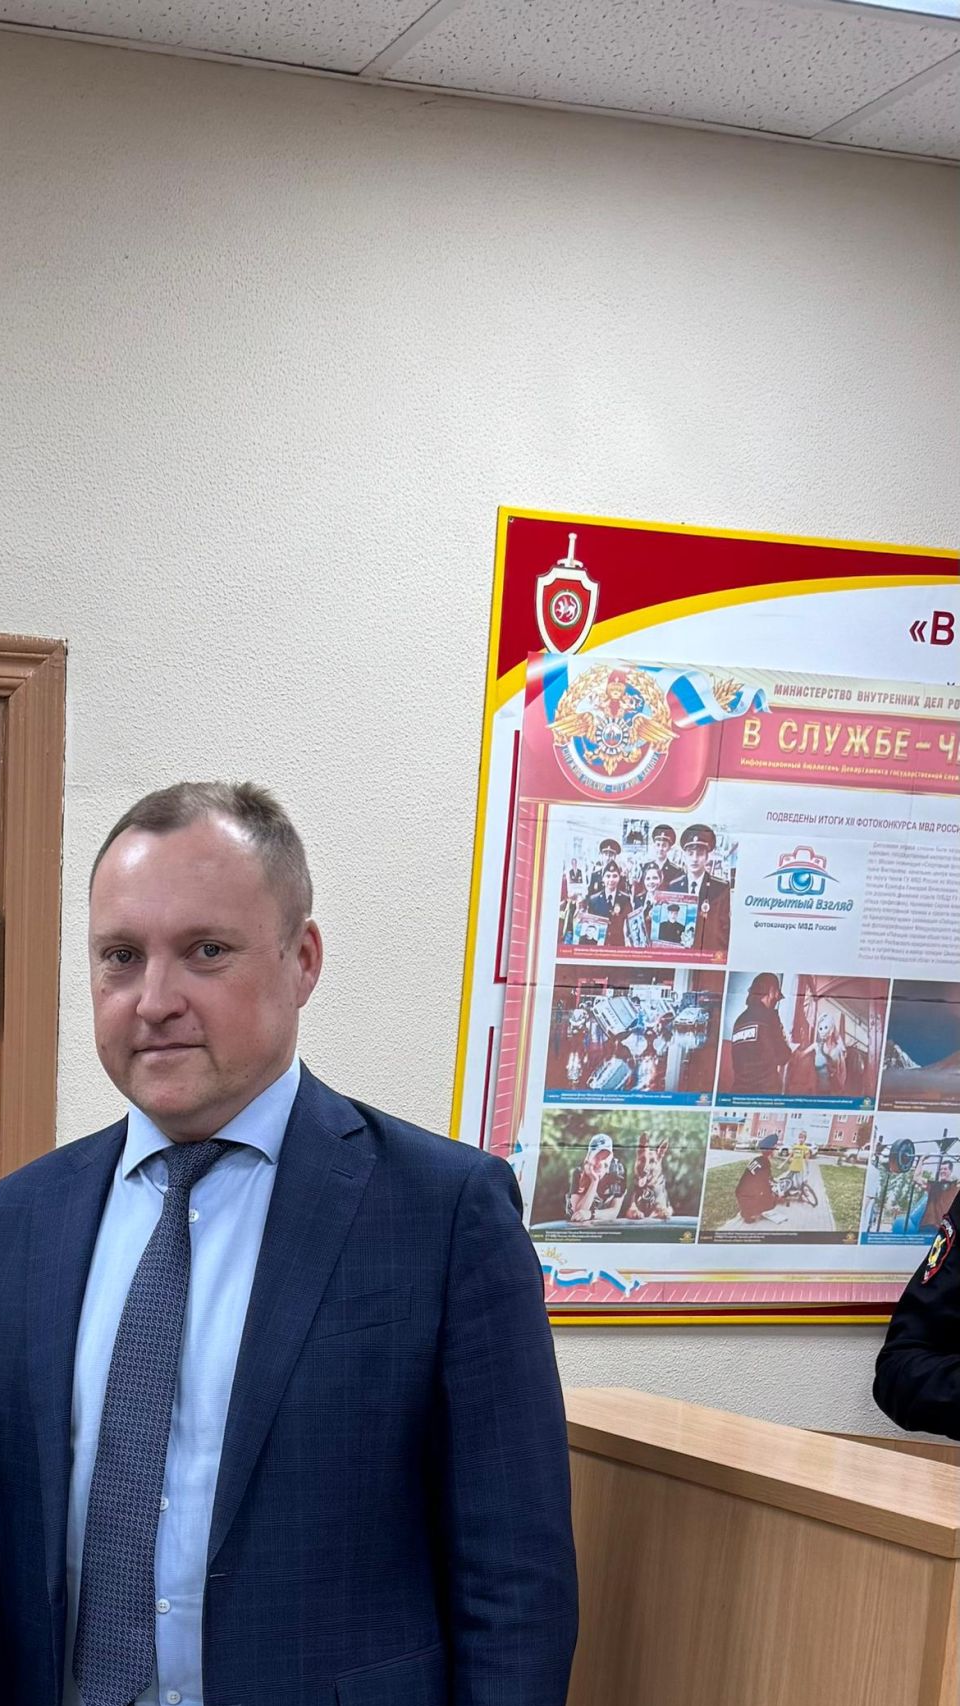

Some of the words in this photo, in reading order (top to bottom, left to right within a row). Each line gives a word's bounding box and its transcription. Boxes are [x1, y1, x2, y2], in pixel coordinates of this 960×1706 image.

[908, 610, 955, 646] «В
[774, 684, 852, 701] МИНИСТЕРСТВО
[857, 690, 920, 707] ВНУТРЕННИХ
[923, 695, 944, 709] ДЕЛ
[742, 716, 762, 749] В
[740, 757, 801, 769] Информационный
[840, 764, 889, 776] Департамента
[766, 811, 817, 824] ПОДВЕДЕНЫ
[818, 815, 843, 826] ИТОГИ
[845, 817, 855, 826] XII
[856, 817, 917, 831] ФОТОКОНКУРСА
[918, 822, 935, 833] МВД
[744, 895, 815, 911] Открытый
[754, 920, 797, 931] Фотоконкурс
[798, 922, 813, 931] МВД
[814, 923, 837, 932] России
